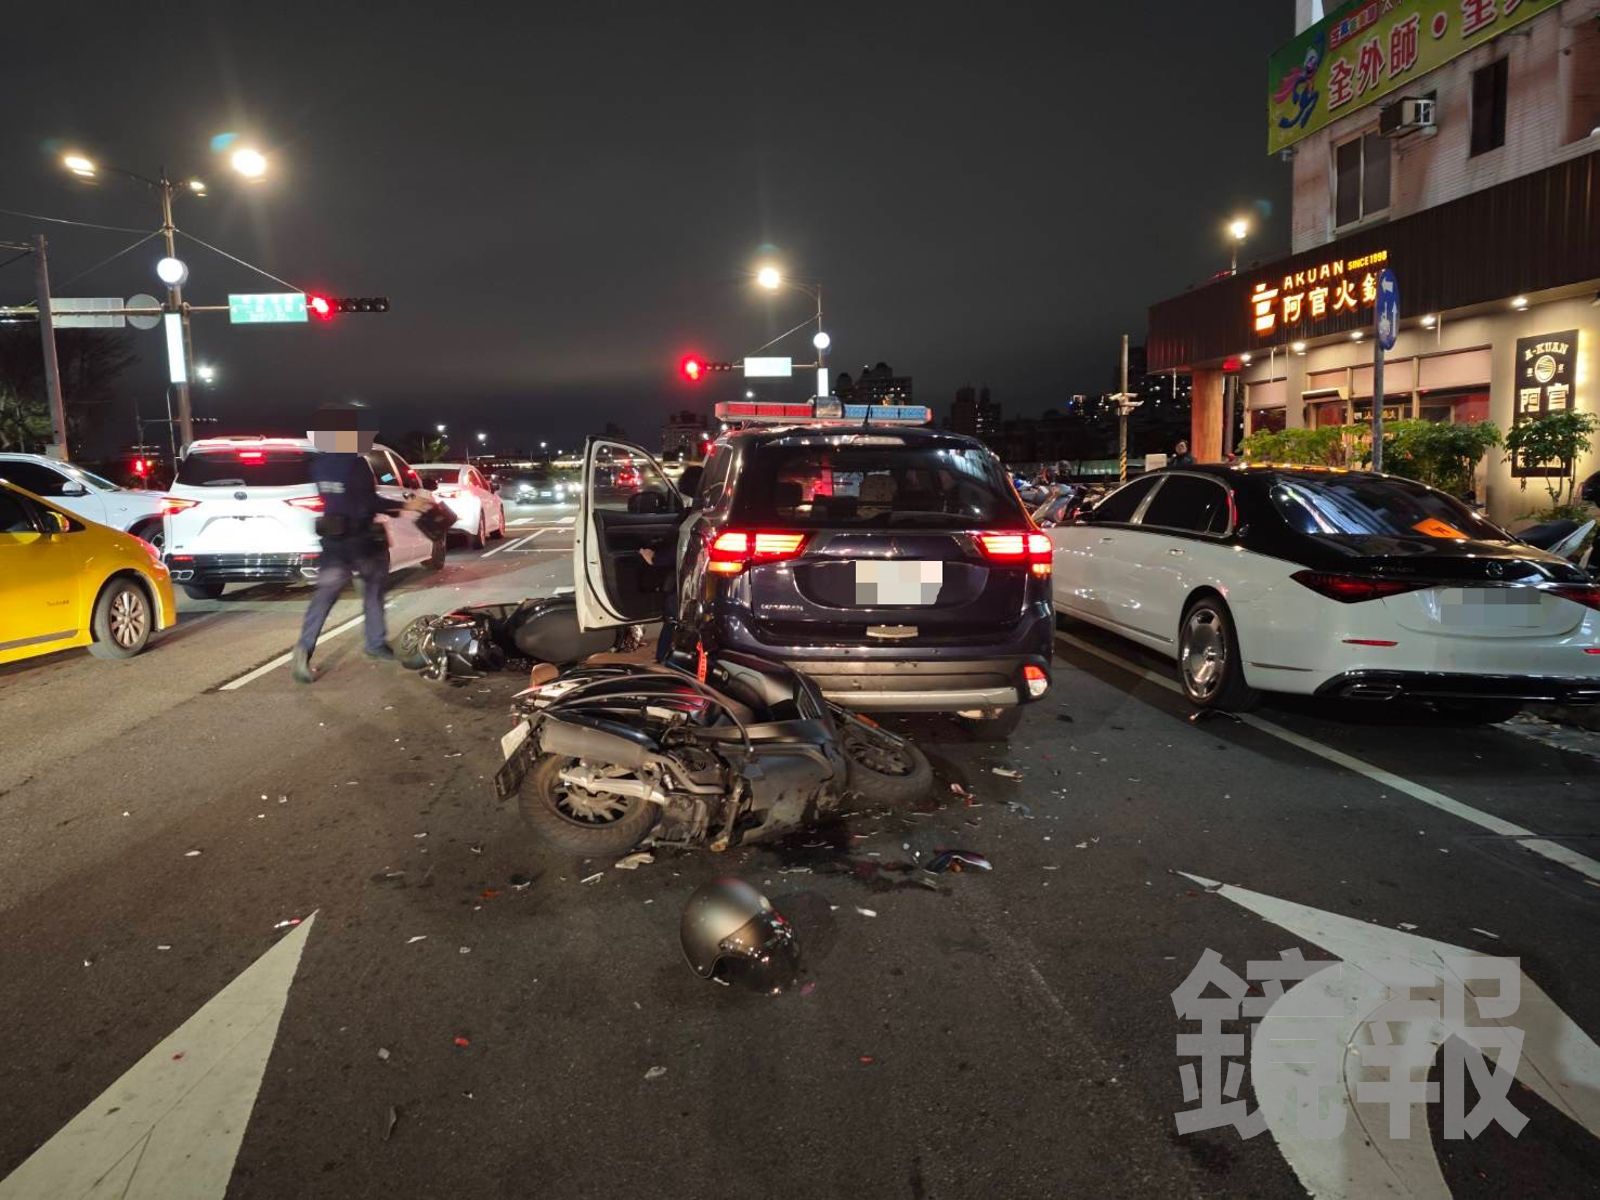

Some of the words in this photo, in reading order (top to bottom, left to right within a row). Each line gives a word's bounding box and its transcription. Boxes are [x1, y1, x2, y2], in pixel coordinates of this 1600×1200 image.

[1283, 259, 1344, 290] AKUAN
[1347, 256, 1369, 271] SINCE
[1525, 342, 1569, 360] A-KUAN
[1520, 383, 1570, 412] 阿官
